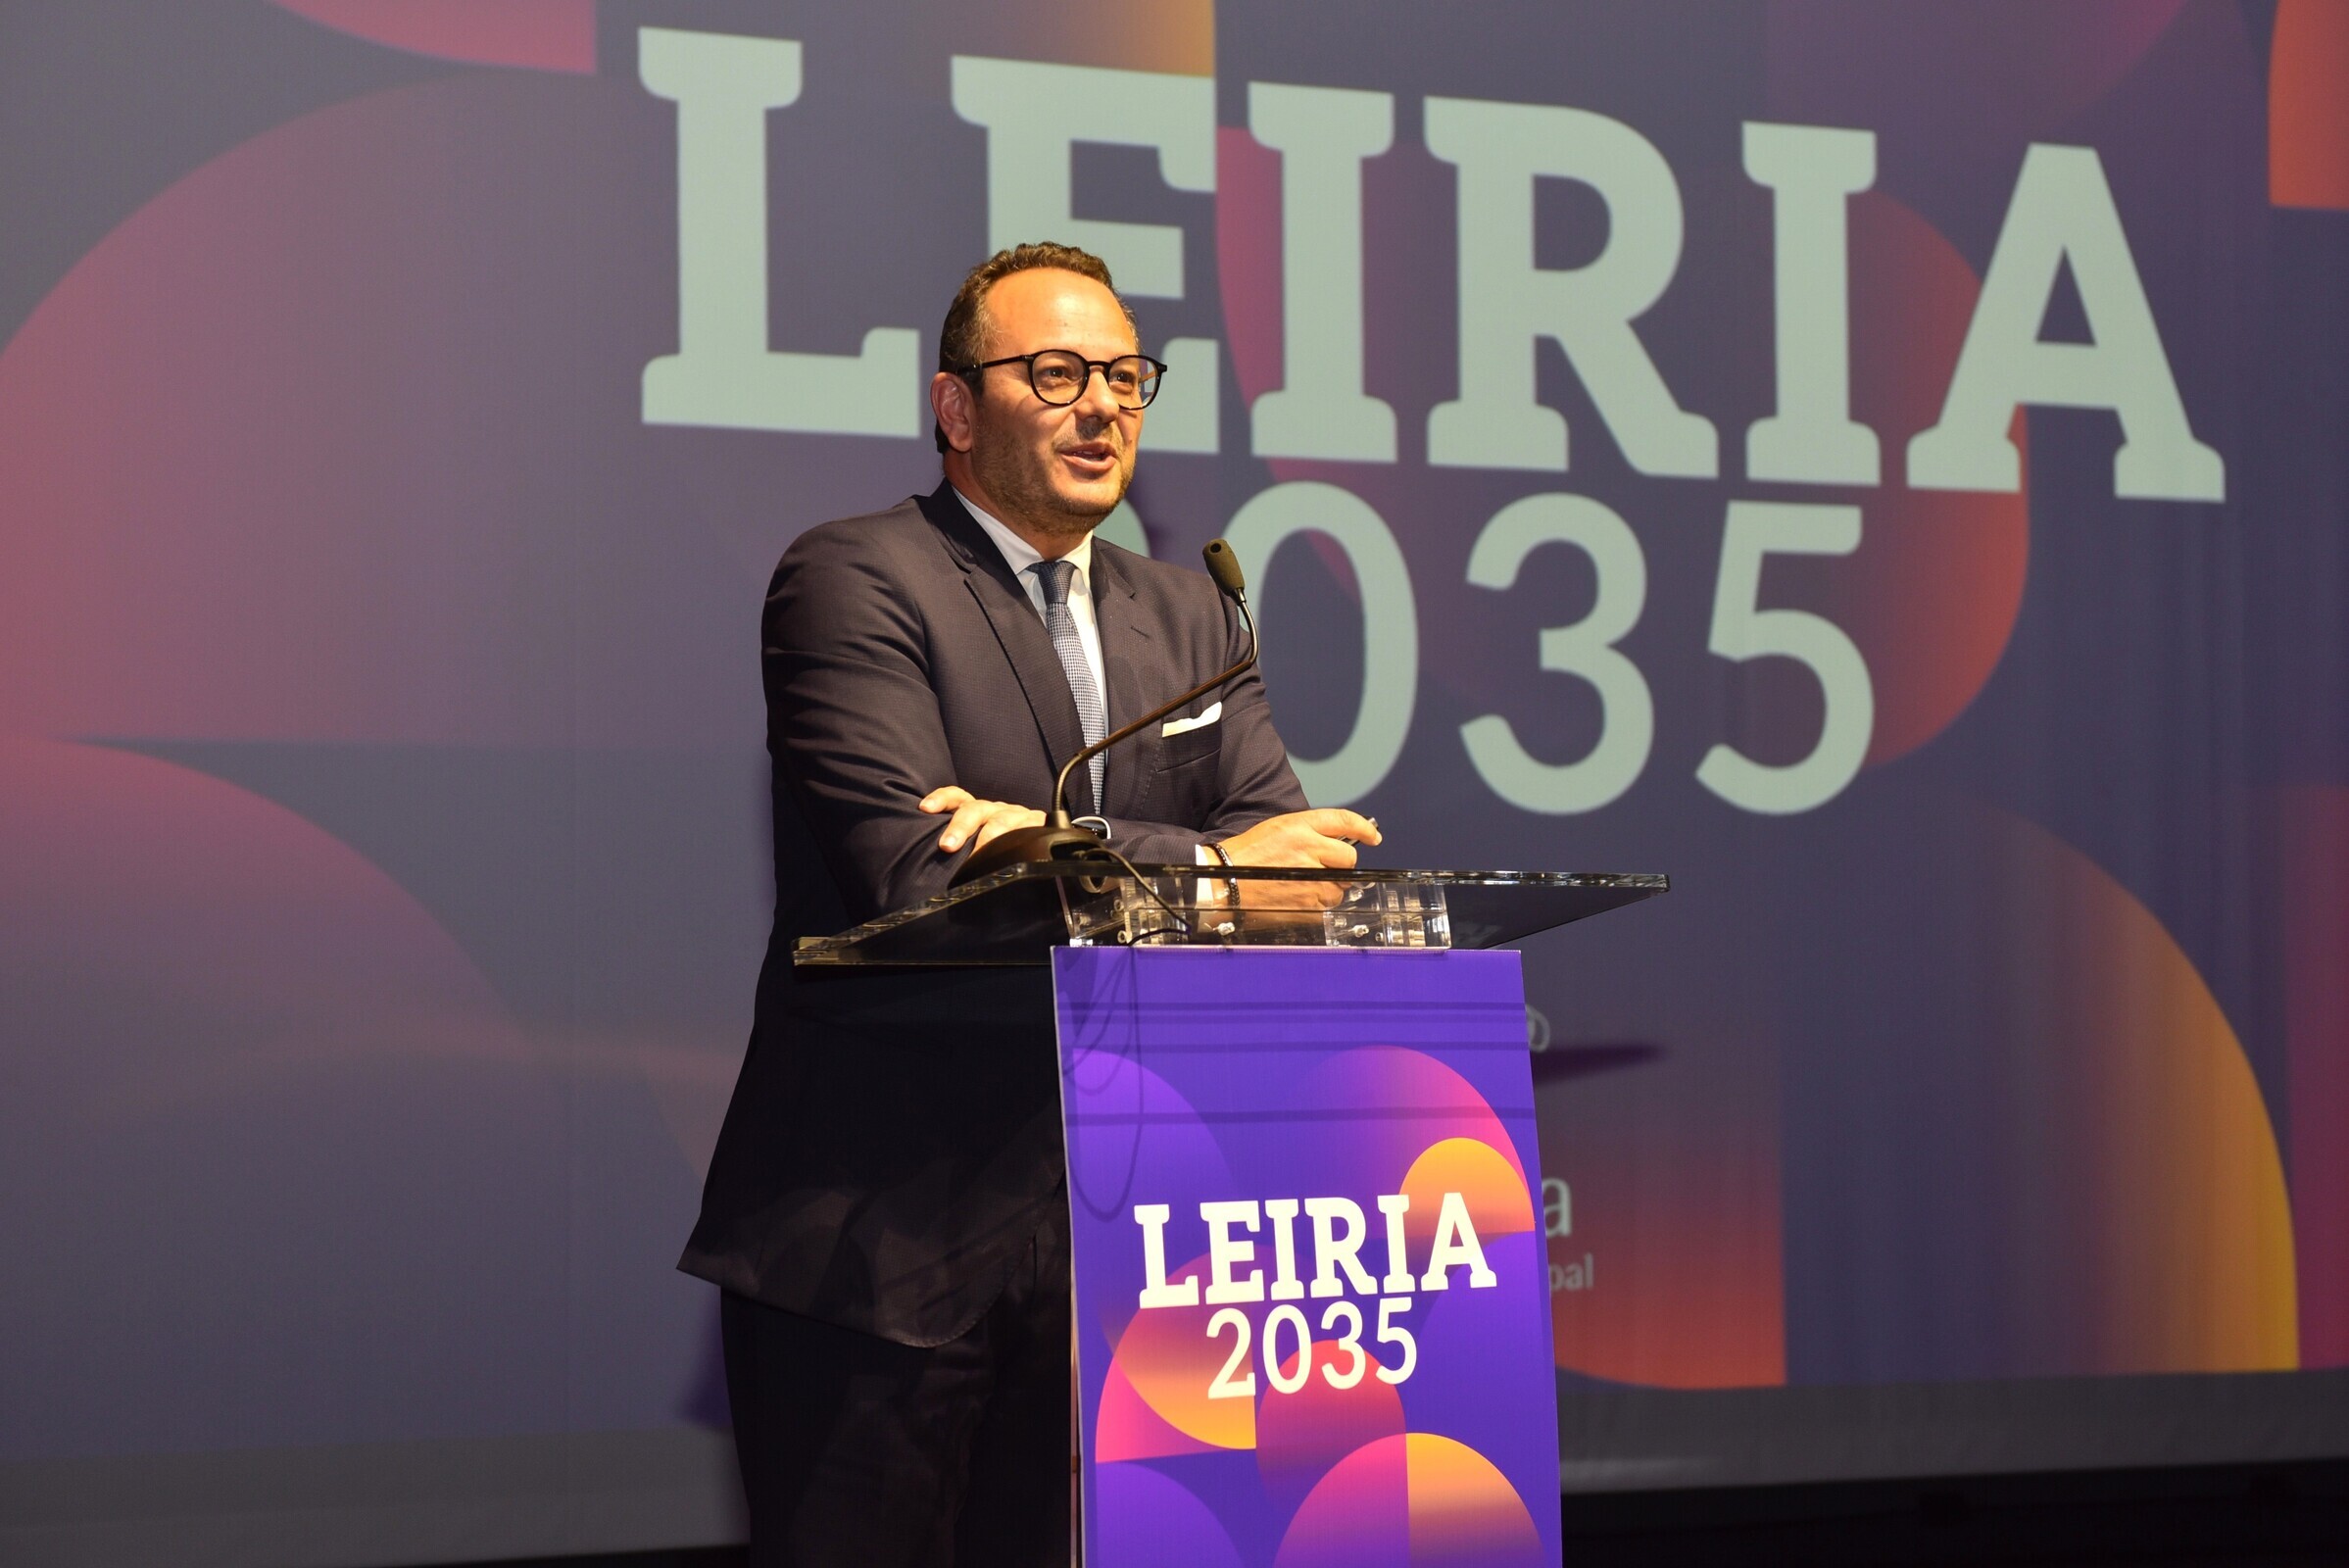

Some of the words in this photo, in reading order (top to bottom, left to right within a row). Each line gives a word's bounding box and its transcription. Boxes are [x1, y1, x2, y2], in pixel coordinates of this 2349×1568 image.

[639, 26, 2226, 502] LEIRIA
[1100, 480, 1875, 815] 035
[1134, 1192, 1497, 1308] LEIRIA
[1206, 1298, 1417, 1398] 2035
